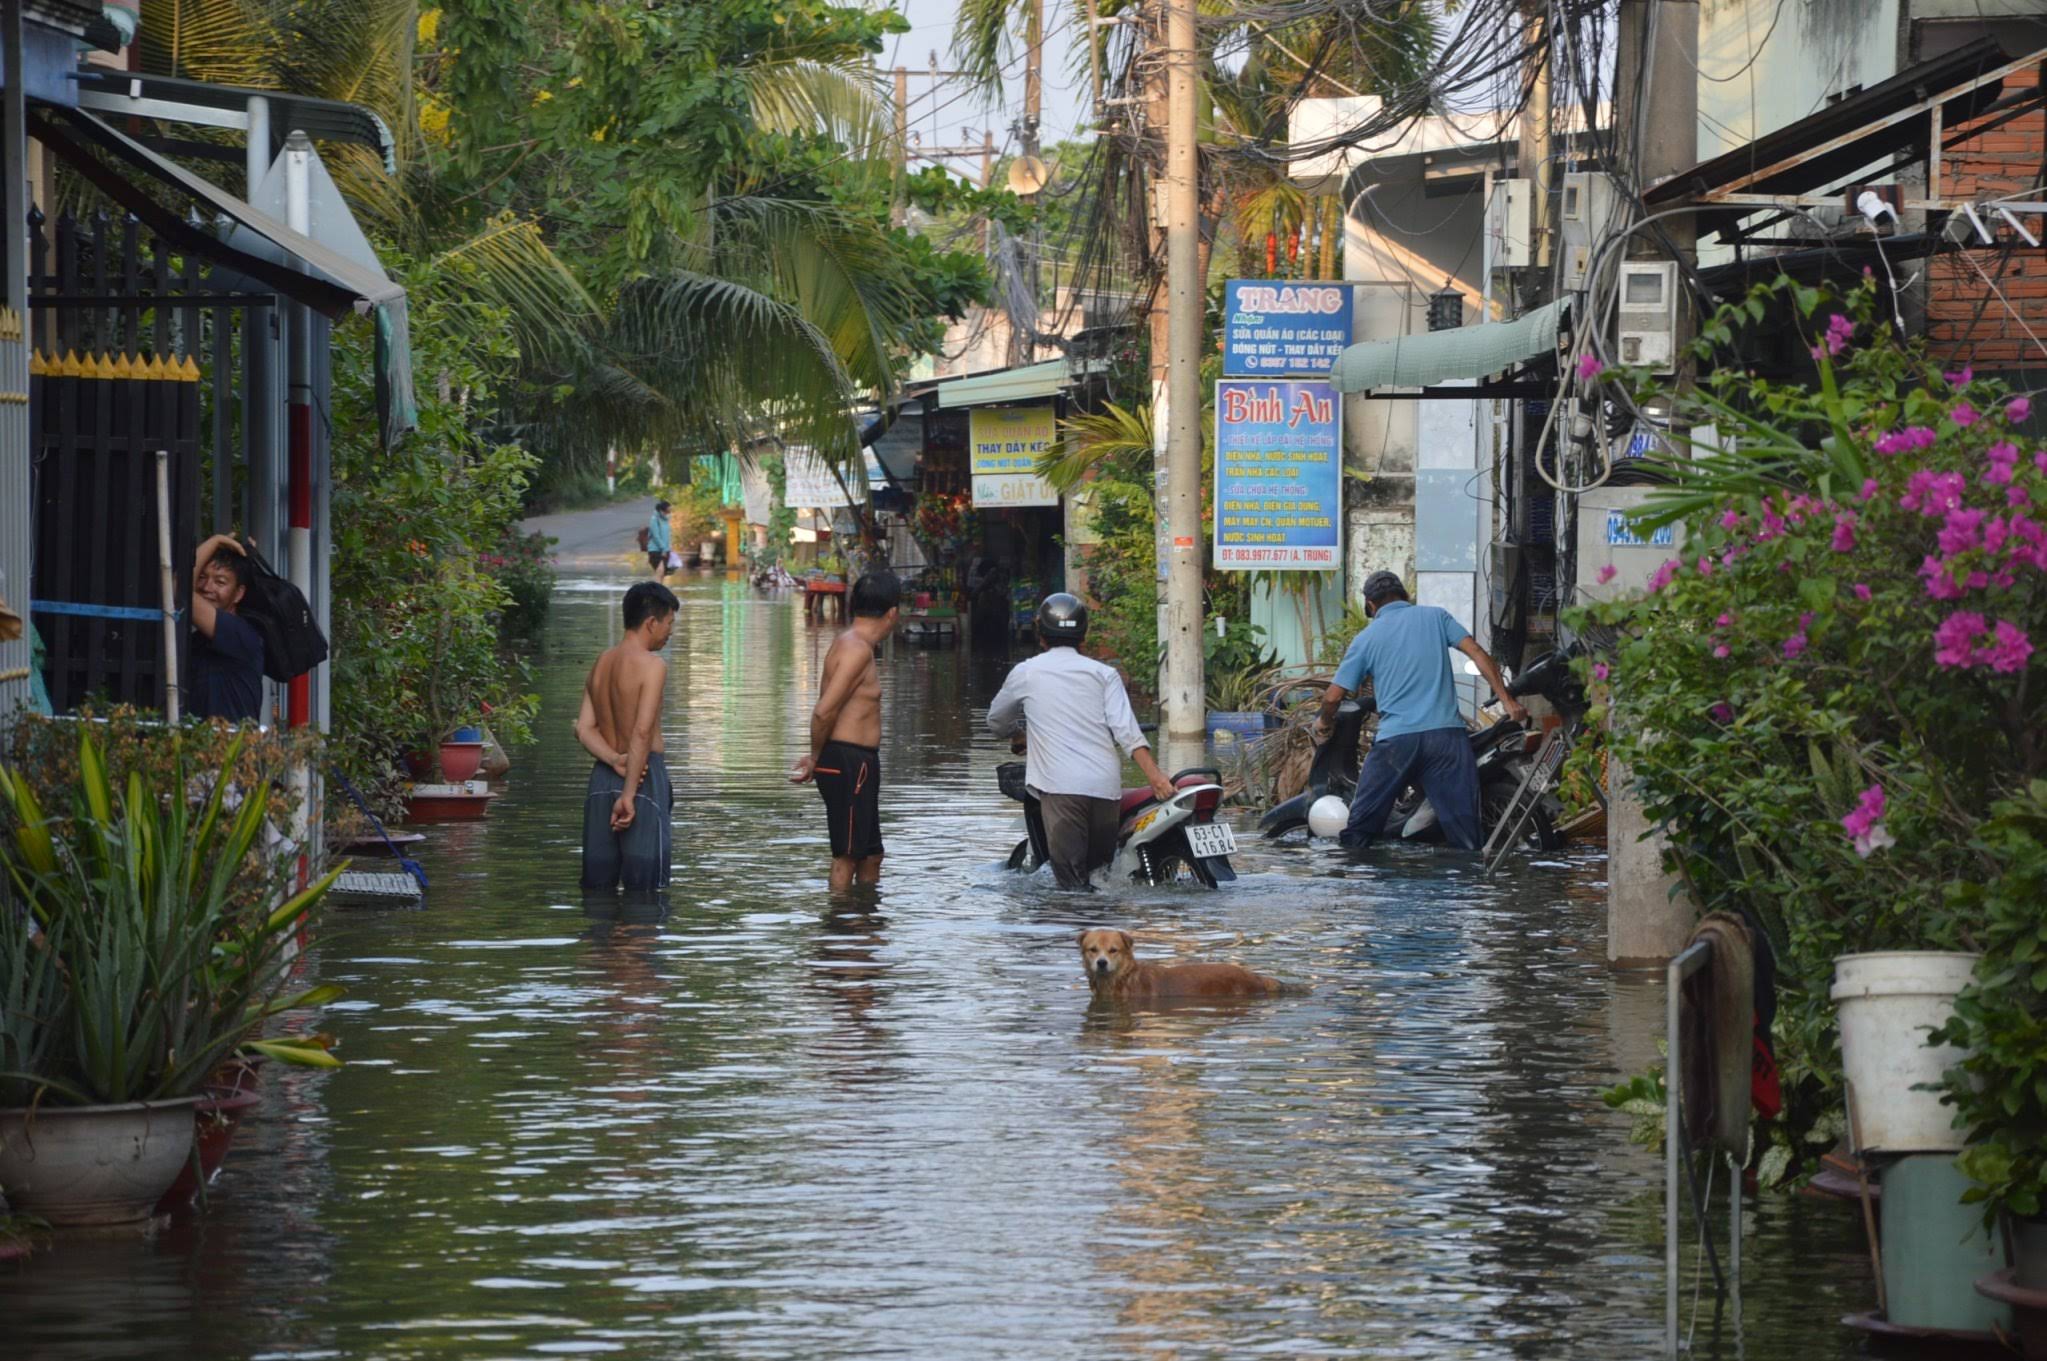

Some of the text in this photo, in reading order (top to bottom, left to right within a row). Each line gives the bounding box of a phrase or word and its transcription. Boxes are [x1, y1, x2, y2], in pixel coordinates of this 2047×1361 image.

[1236, 286, 1343, 314] TRANG
[1281, 327, 1294, 340] ÁO
[1284, 344, 1306, 355] THAY
[1223, 386, 1333, 428] Bình An
[976, 443, 1001, 454] THAY
[1194, 826, 1224, 840] 63-C1
